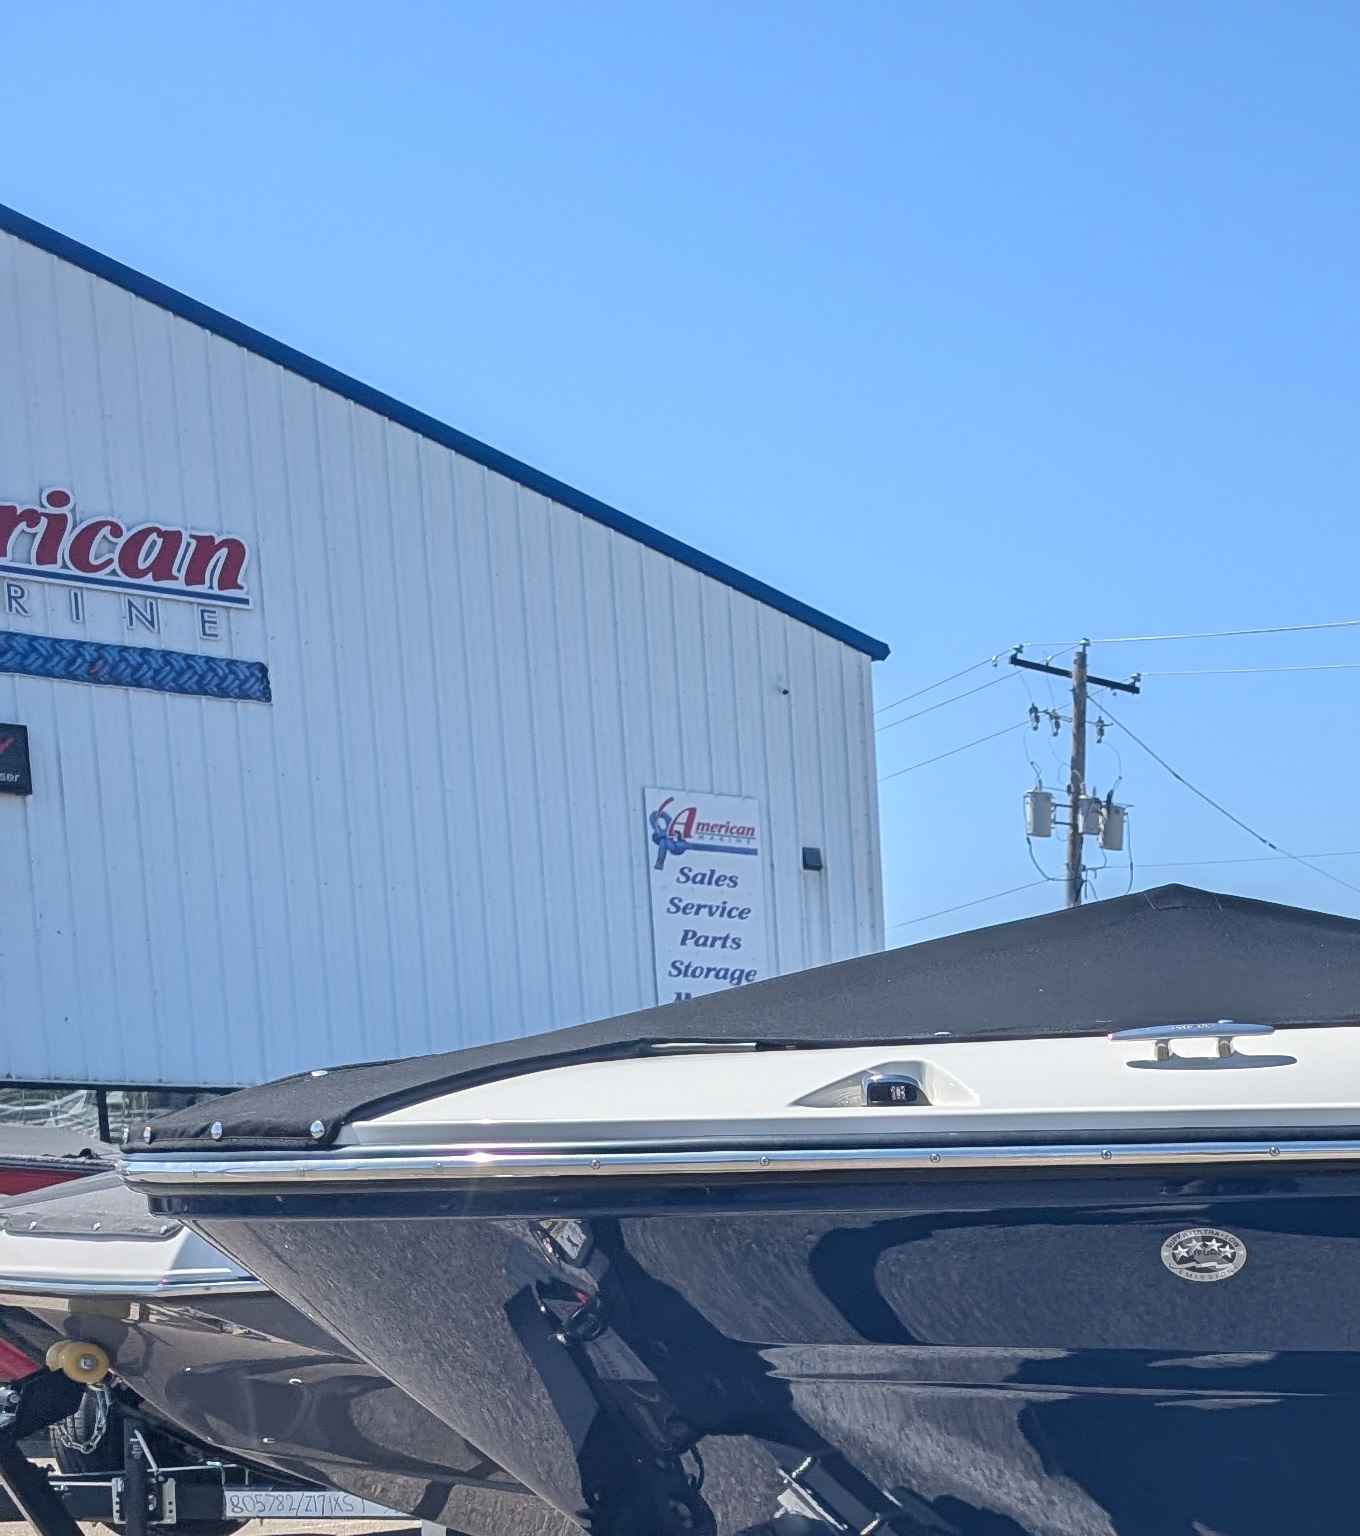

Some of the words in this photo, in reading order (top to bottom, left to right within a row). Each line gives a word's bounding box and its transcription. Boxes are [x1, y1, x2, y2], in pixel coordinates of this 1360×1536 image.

[6, 583, 219, 638] RINE
[668, 806, 756, 839] American
[676, 866, 739, 889] Sales
[666, 896, 752, 921] Service
[679, 928, 743, 951] Parts
[668, 959, 757, 986] Storage
